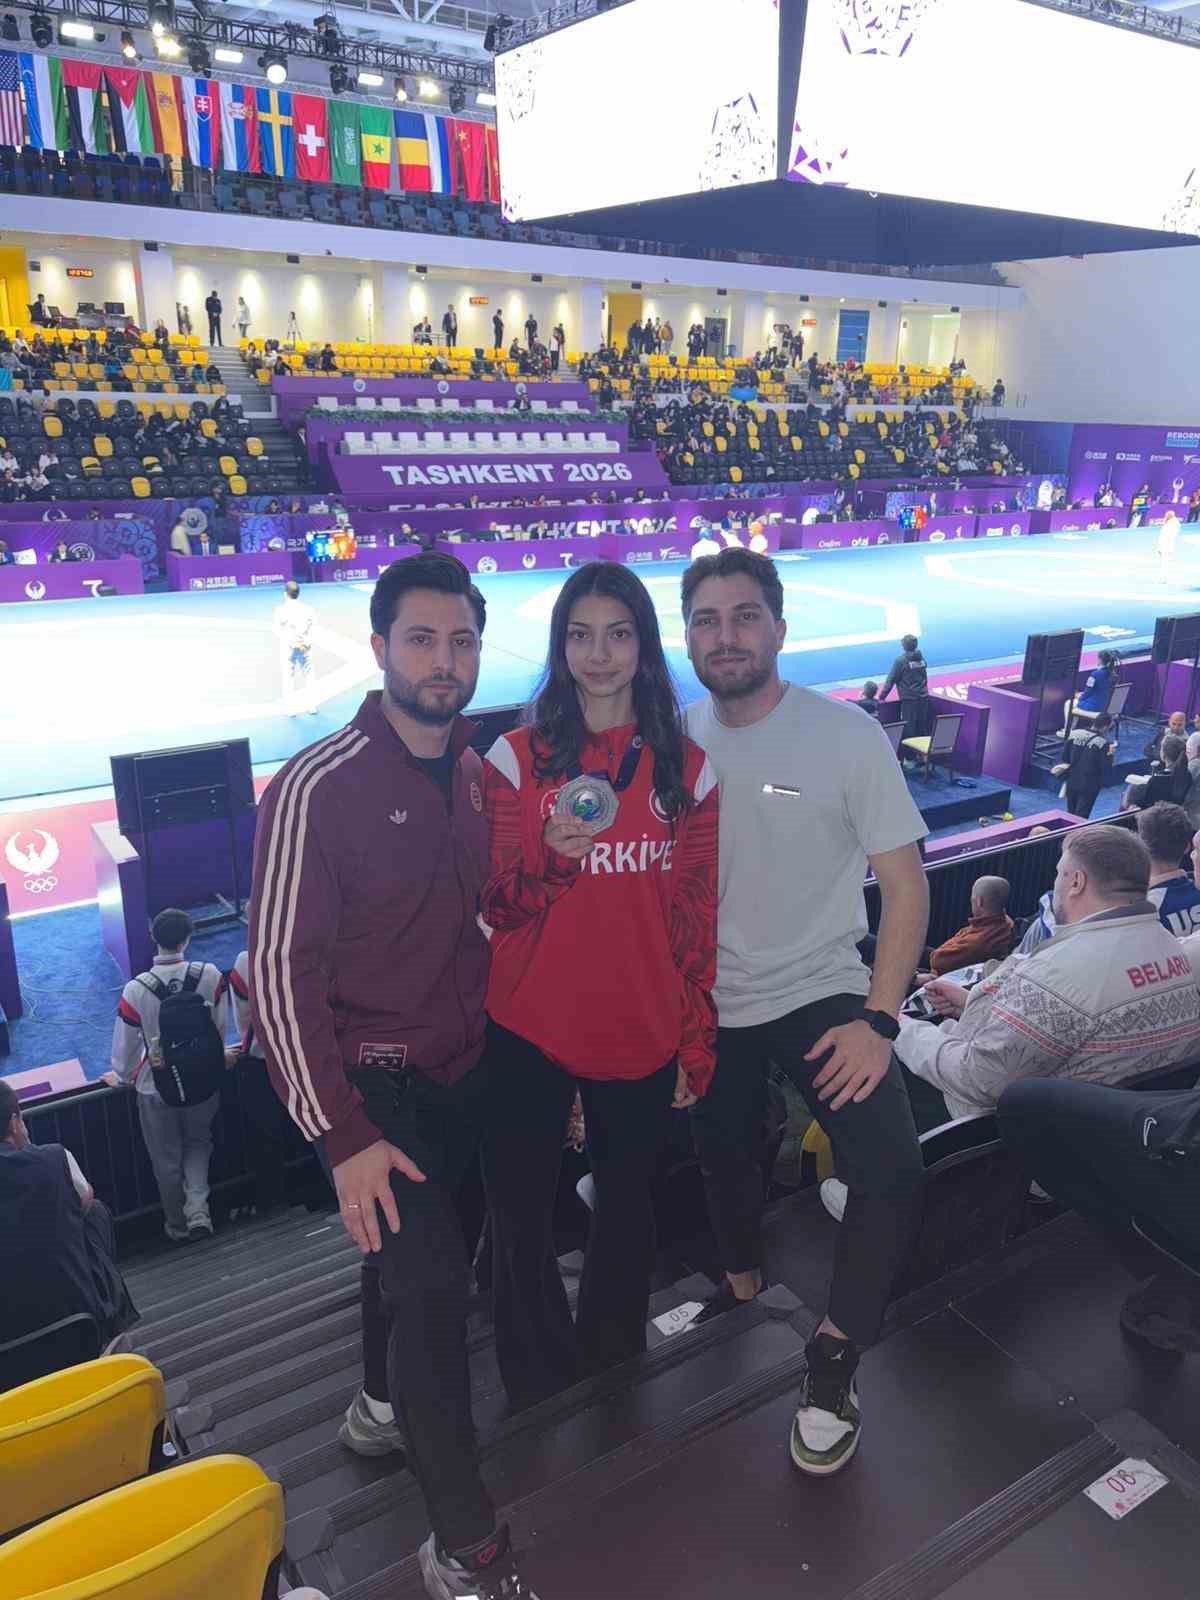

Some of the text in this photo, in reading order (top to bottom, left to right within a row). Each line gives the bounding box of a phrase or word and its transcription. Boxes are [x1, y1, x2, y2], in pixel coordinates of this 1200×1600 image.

[381, 462, 633, 486] TASHKENT 2026
[580, 833, 677, 874] RKİYE
